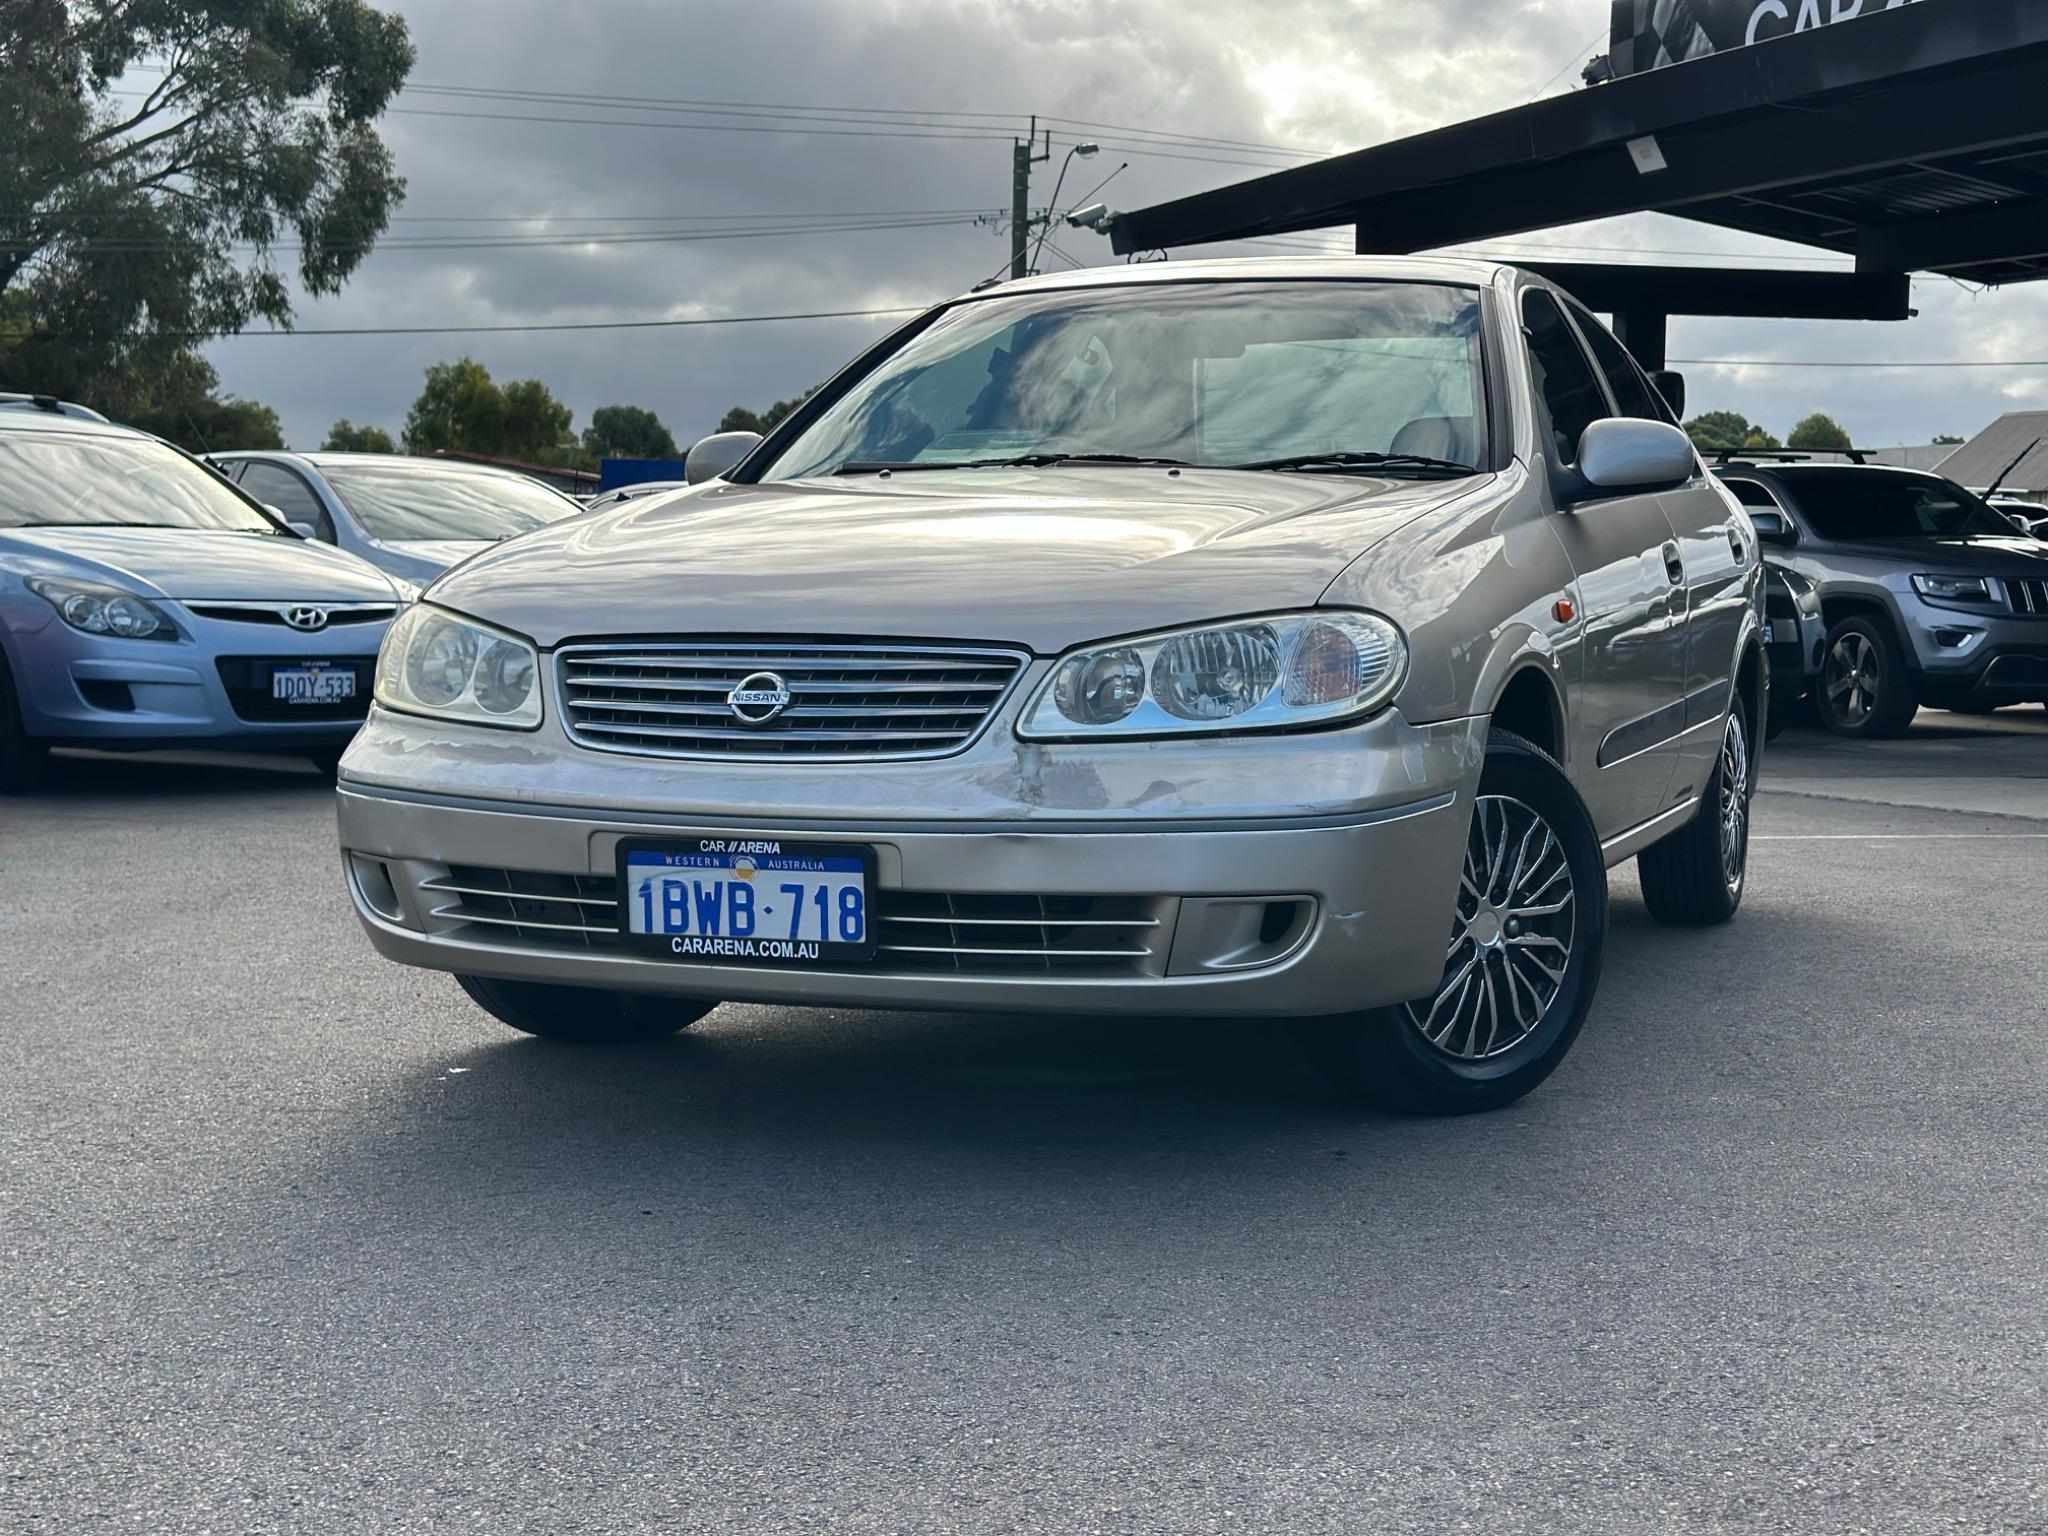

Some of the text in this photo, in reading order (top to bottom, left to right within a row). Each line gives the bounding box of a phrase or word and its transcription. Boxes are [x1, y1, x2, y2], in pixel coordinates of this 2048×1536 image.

[732, 693, 781, 702] NISSAN
[700, 840, 726, 853] CAR
[665, 856, 825, 871] WESTERN AUSTRALIA
[671, 937, 819, 959] CARARENA.COM.AU
